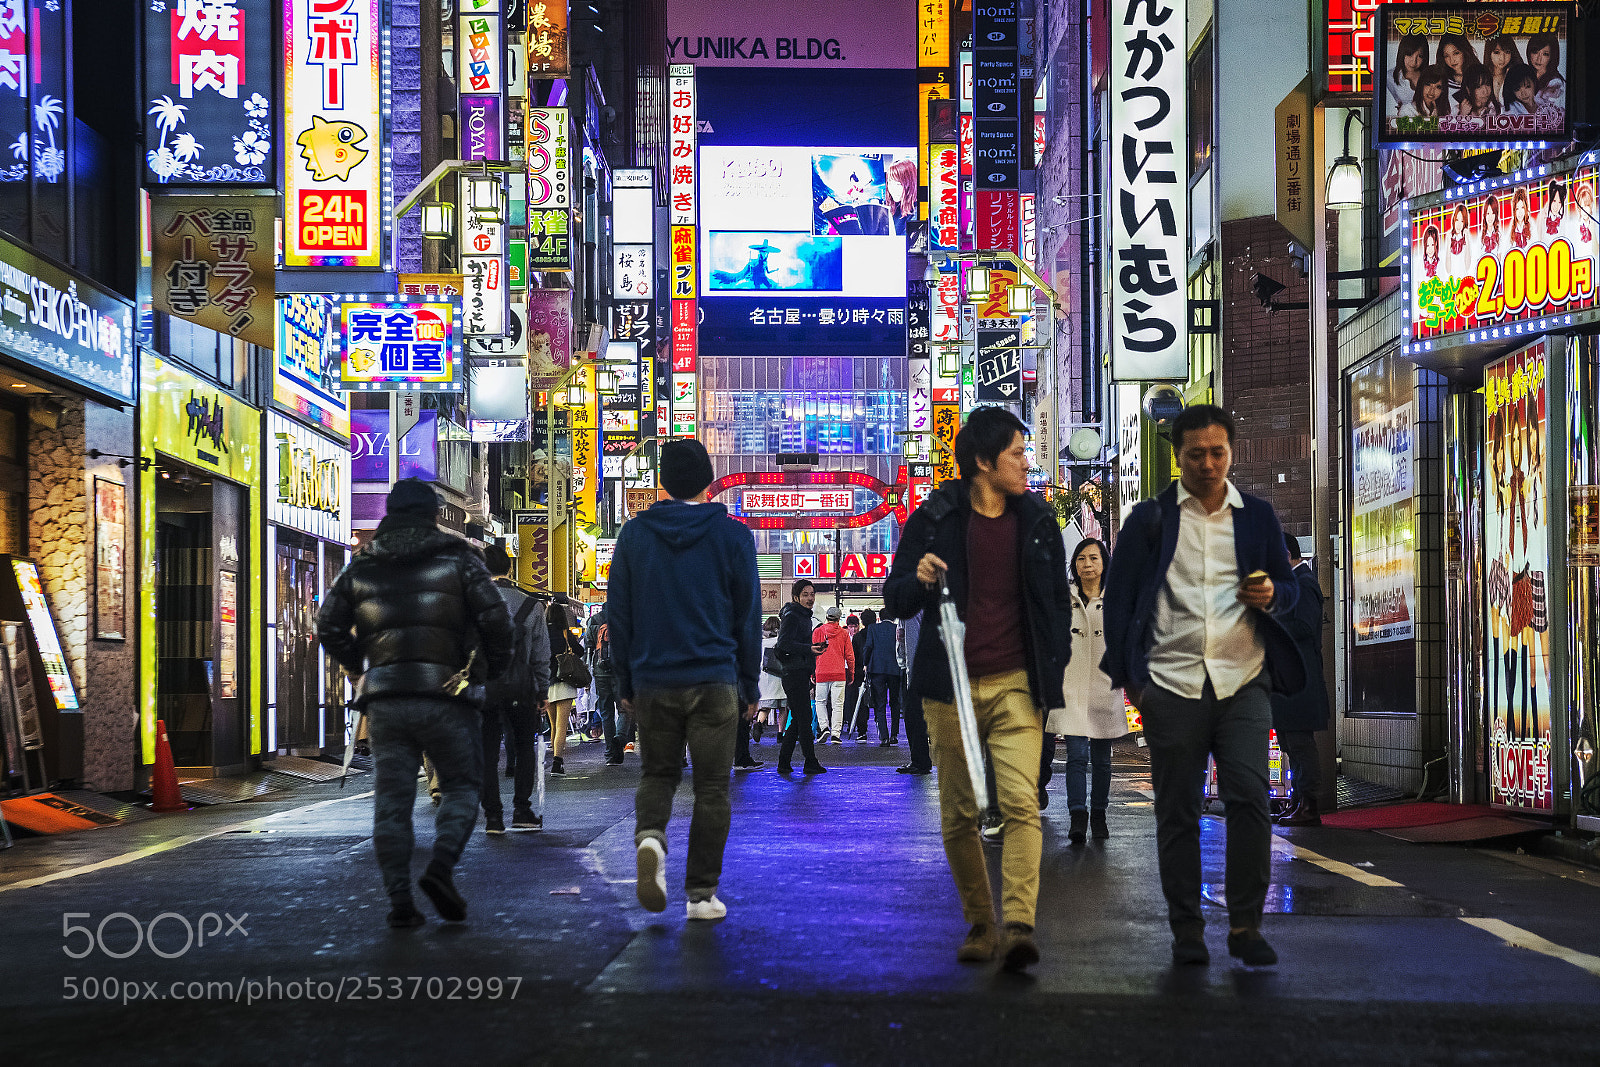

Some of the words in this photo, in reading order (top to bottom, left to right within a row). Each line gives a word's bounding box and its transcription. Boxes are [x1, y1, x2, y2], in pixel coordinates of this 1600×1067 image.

[178, 0, 239, 98] 焼肉
[470, 19, 490, 90] ビックワン
[667, 37, 769, 60] YUNIKA
[775, 38, 847, 61] BLDG.
[532, 63, 551, 71] 5F
[937, 72, 945, 82] 5
[672, 89, 693, 211] お好み焼き
[1286, 114, 1301, 213] 劇場通り一番街
[212, 212, 252, 231] 全品
[302, 195, 364, 223] 24h
[302, 226, 362, 246] OPEN
[474, 237, 490, 248] 1F
[540, 237, 567, 256] 4F
[1476, 239, 1592, 319] 2,000円
[30, 276, 98, 351] SEIKO-EN
[352, 313, 414, 342] 完全
[677, 333, 691, 341] 117
[380, 343, 442, 372] 個室
[677, 357, 692, 368] 4F
[979, 349, 1020, 386] RIZ
[746, 493, 849, 508] 歌舞伎町一番街
